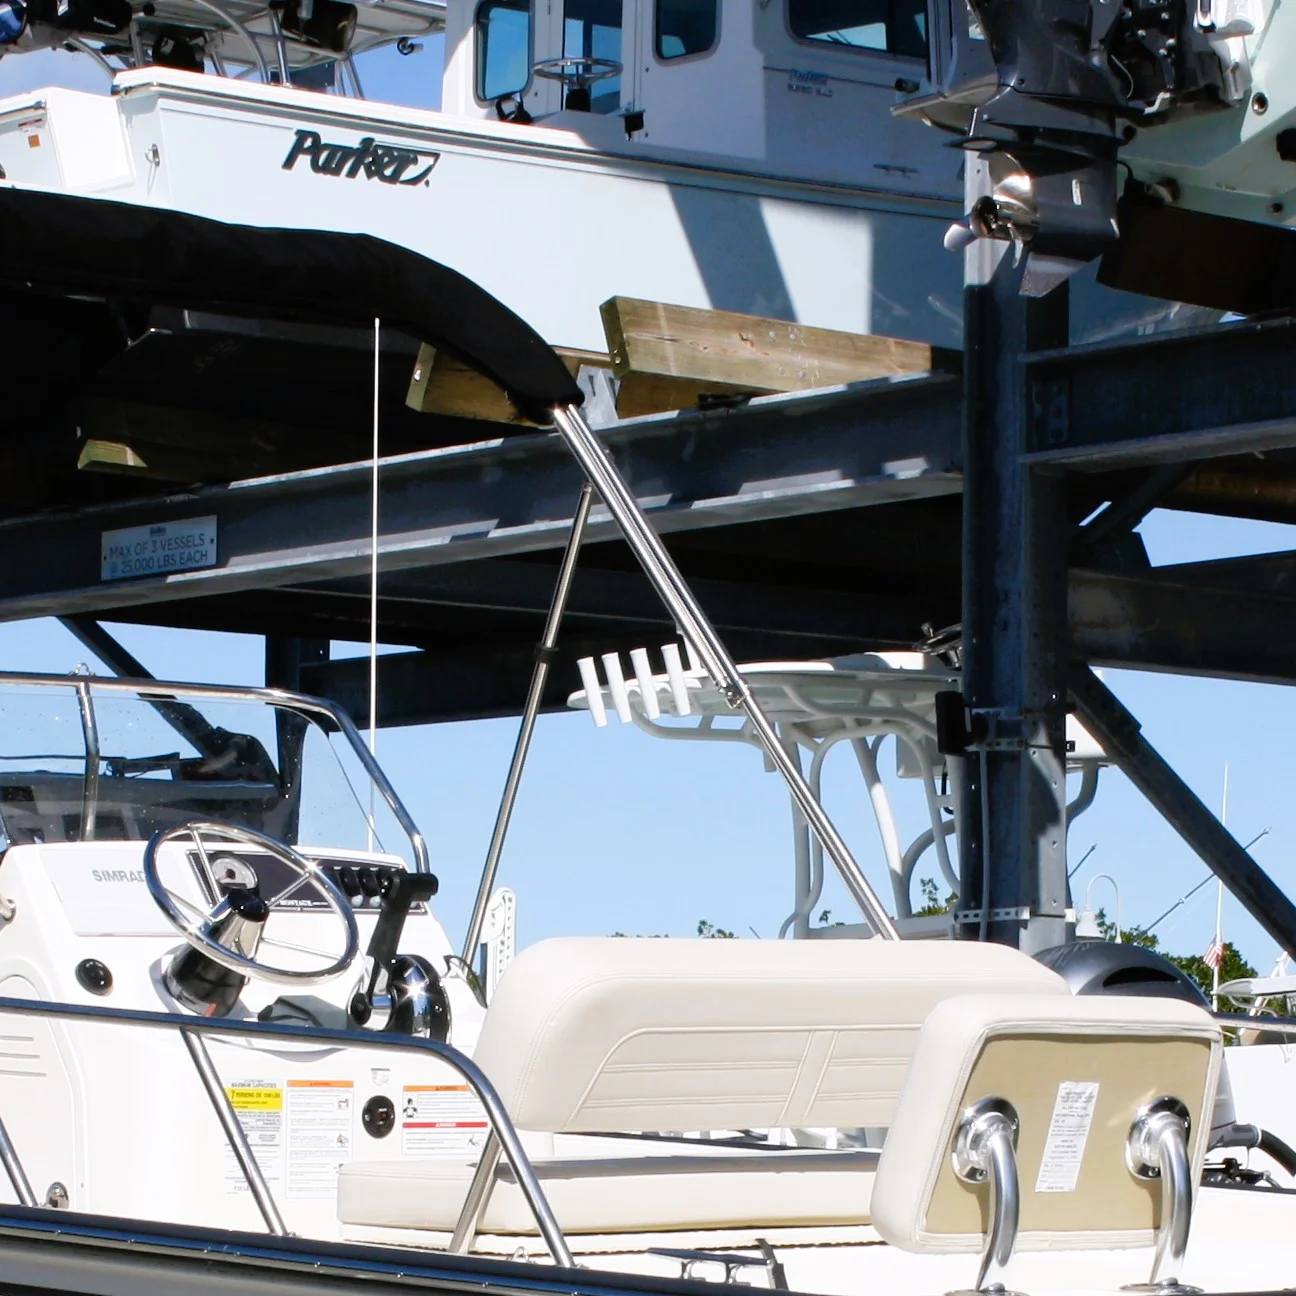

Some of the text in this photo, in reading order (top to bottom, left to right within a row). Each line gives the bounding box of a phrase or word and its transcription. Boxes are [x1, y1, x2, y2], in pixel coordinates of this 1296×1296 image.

[281, 129, 440, 187] Parker
[109, 533, 205, 559] MAX OF 3 VESSELS
[157, 555, 177, 569] LBS
[179, 549, 208, 566] EACH
